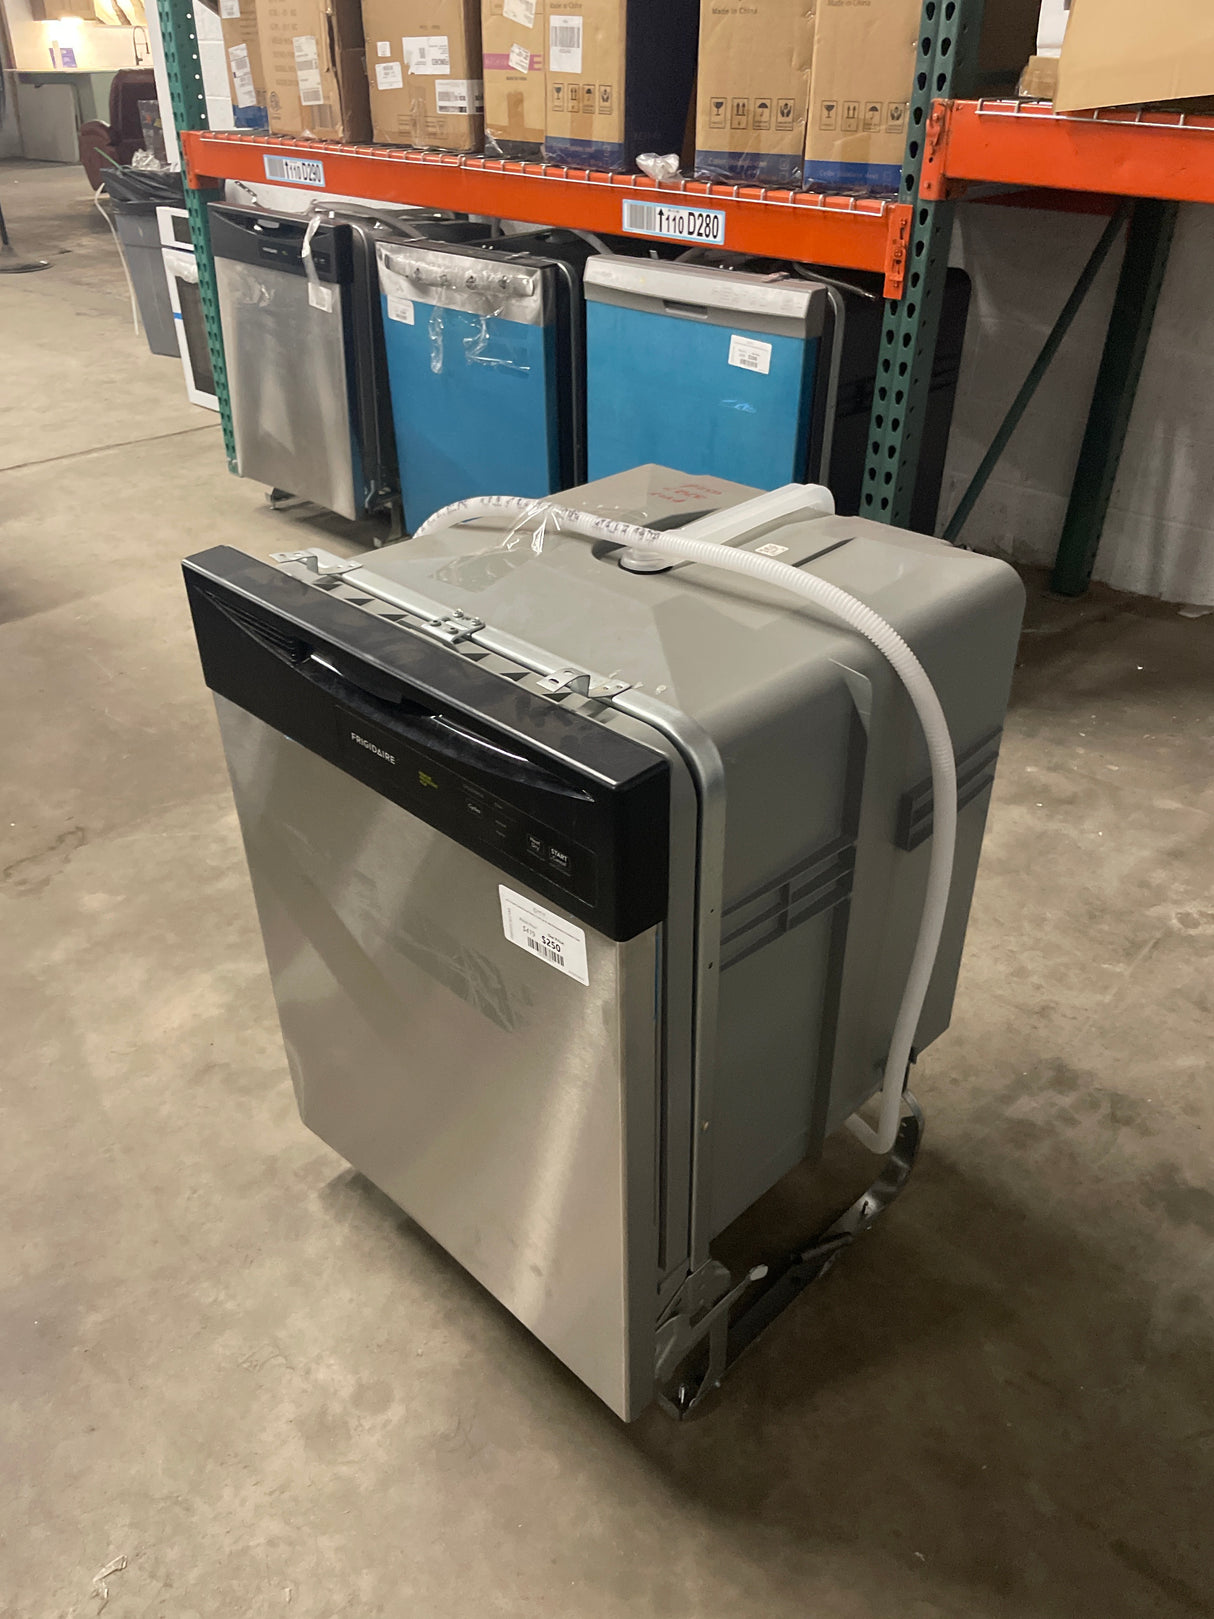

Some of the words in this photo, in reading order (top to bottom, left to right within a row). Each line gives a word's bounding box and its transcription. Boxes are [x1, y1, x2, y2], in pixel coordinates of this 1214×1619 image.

[302, 162, 321, 183] D290
[665, 214, 685, 234] 110
[688, 211, 720, 239] D280
[350, 732, 396, 765] FRIGIDAIRE
[550, 848, 569, 862] START
[541, 935, 561, 953] $250
